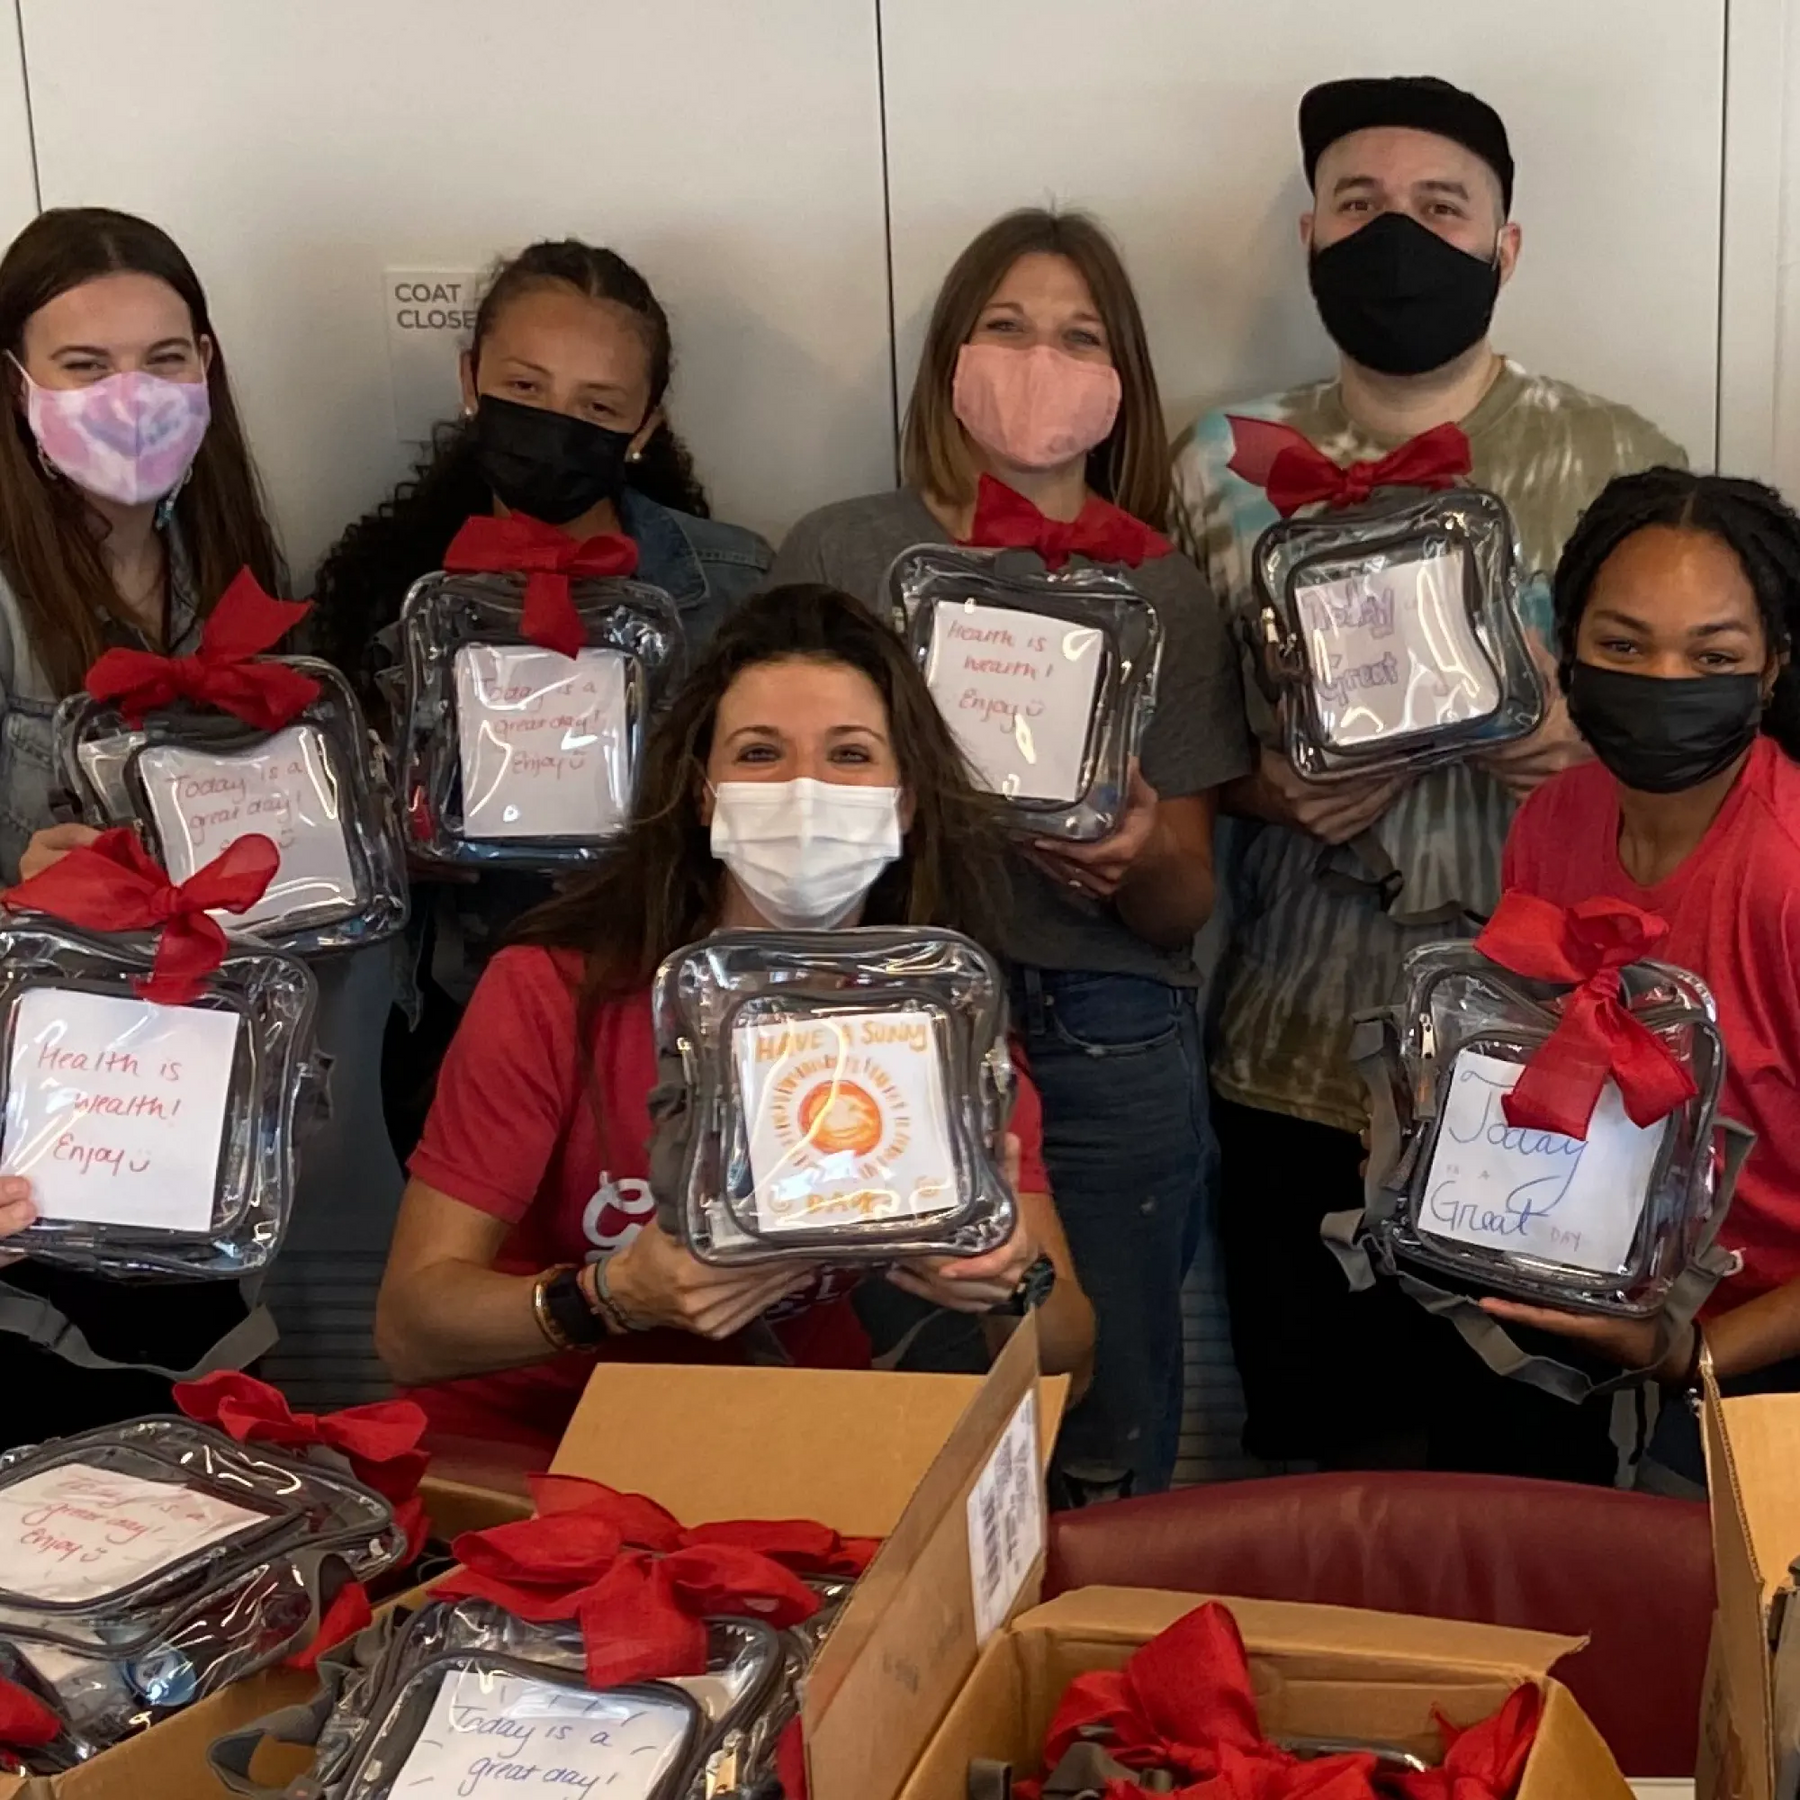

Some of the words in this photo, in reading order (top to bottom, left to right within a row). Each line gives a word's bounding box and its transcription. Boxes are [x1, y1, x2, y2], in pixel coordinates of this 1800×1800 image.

[394, 283, 461, 302] COAT
[396, 309, 478, 329] CLOSE
[948, 620, 1015, 648] Health
[1027, 637, 1048, 652] is
[582, 681, 597, 693] a
[958, 688, 1019, 734] Enjoy
[165, 774, 246, 804] Today
[260, 764, 279, 781] is
[287, 762, 303, 775] a
[512, 752, 563, 779] Enjoy
[190, 807, 240, 847] great
[38, 1043, 140, 1076] Health
[160, 1056, 182, 1081] is
[756, 1028, 825, 1062] HAVE
[53, 1132, 124, 1176] Enjoy
[1551, 1226, 1582, 1251] DAY
[451, 1705, 535, 1760] Today
[545, 1726, 572, 1741] is
[590, 1730, 613, 1747] a
[457, 1756, 542, 1798] great
